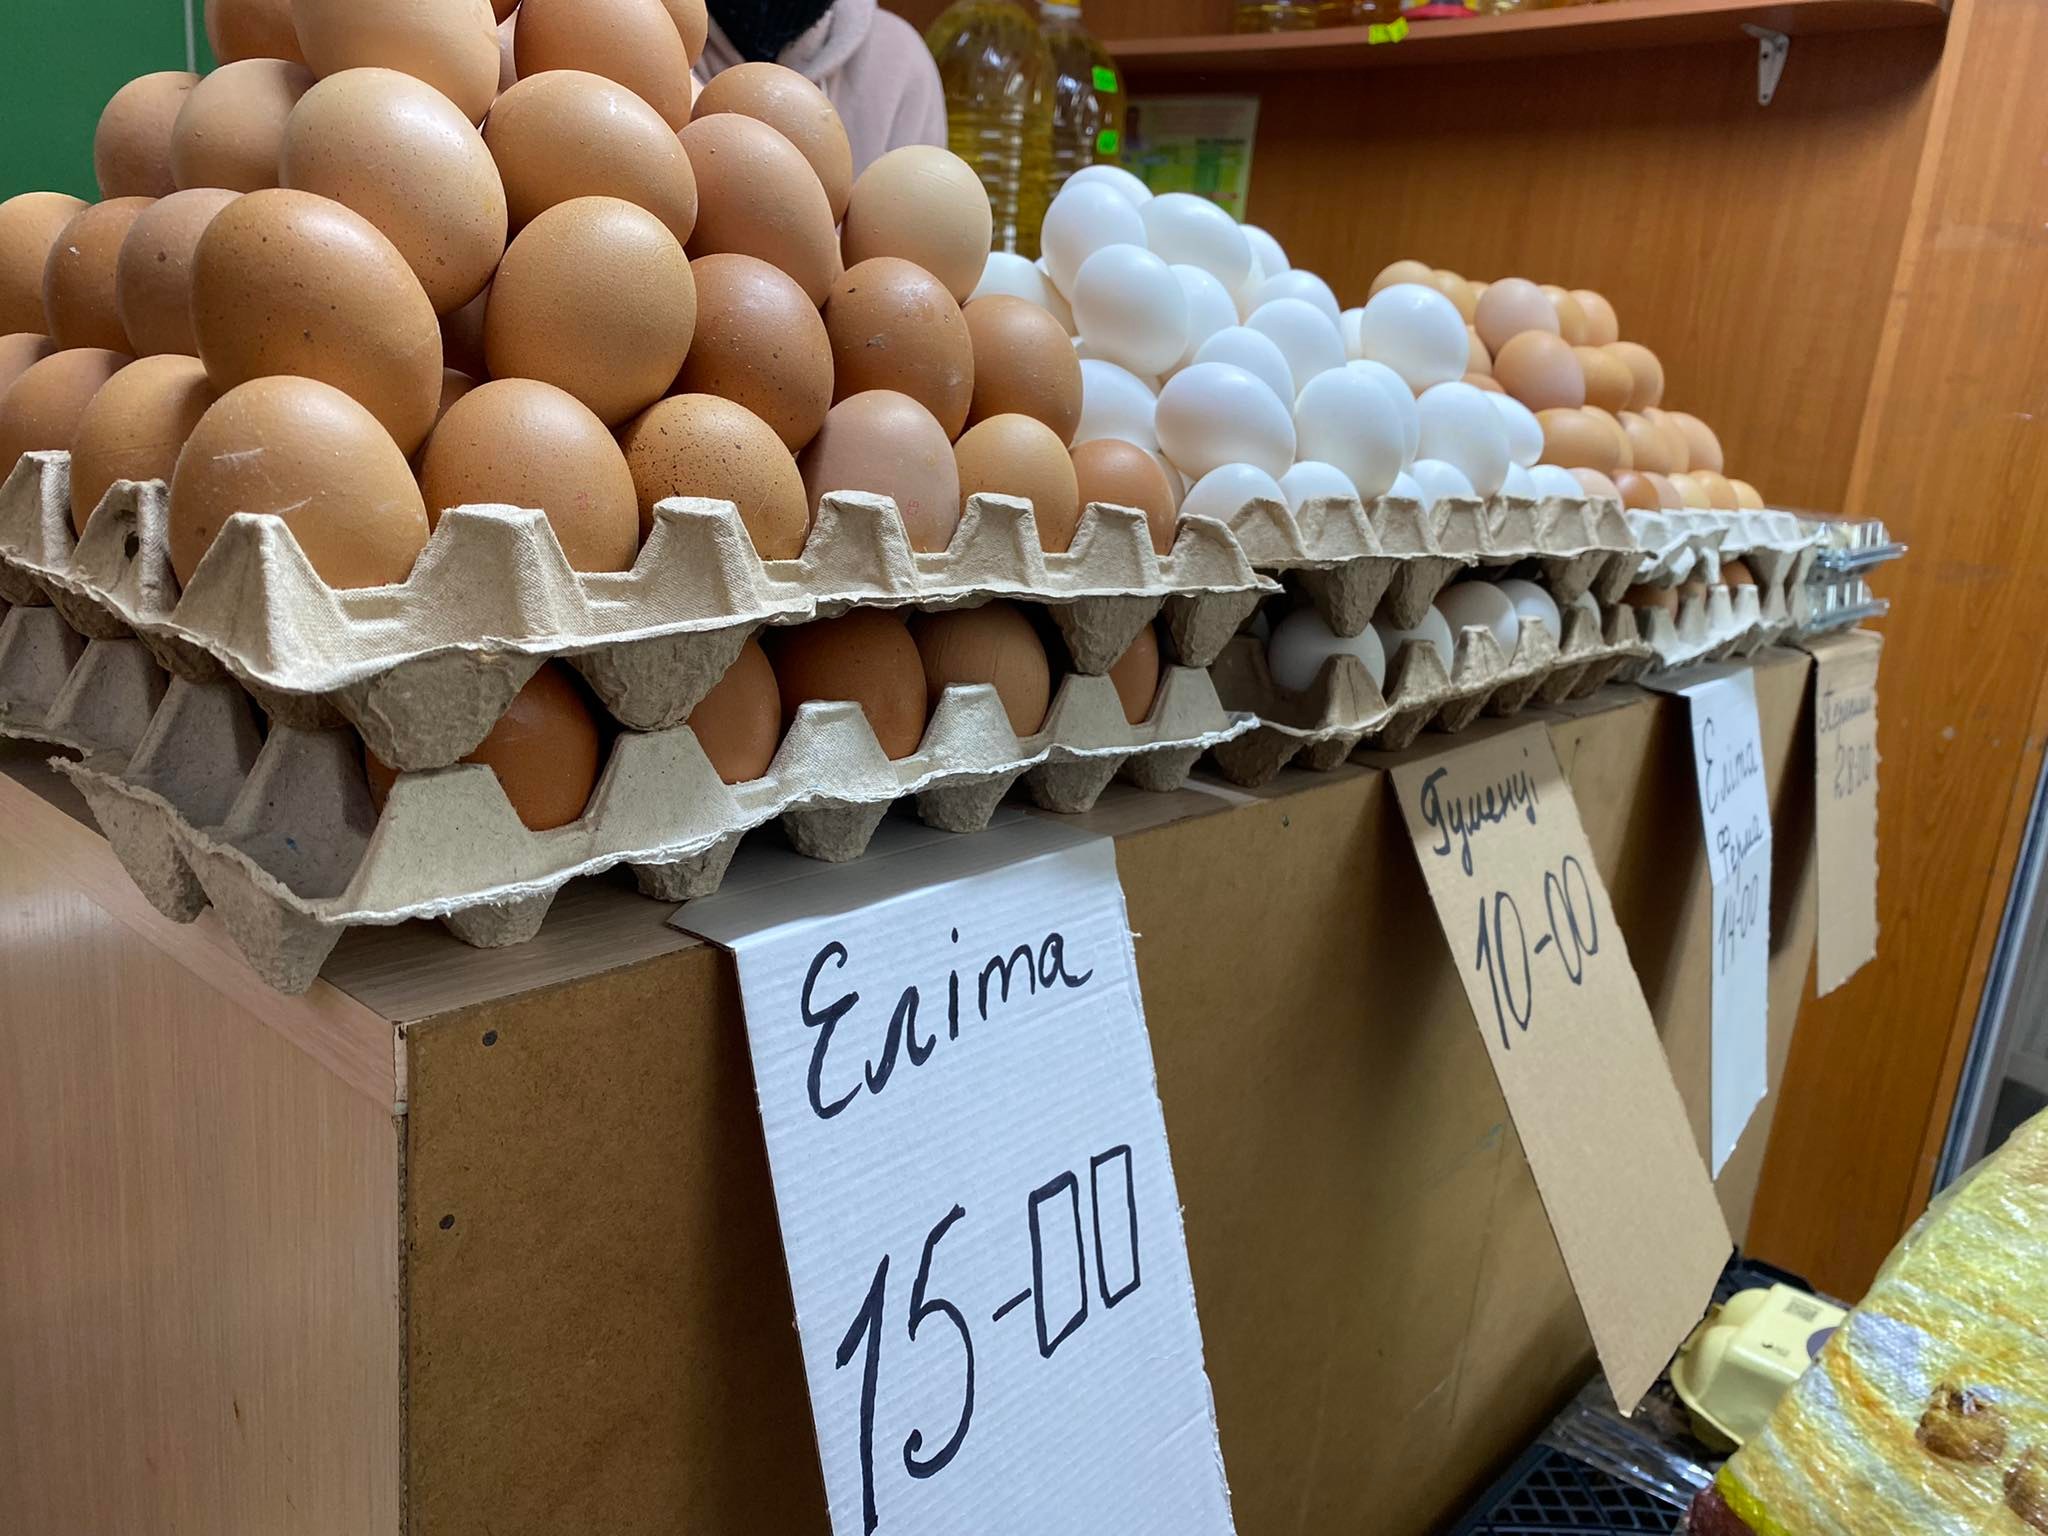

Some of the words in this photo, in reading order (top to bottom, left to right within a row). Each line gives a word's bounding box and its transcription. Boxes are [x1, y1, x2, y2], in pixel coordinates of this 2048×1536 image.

[1476, 855, 1599, 1050] 10-00
[1718, 874, 1760, 976] 14-00
[801, 928, 1093, 1119] Еліта
[836, 1144, 1141, 1536] 15-00
